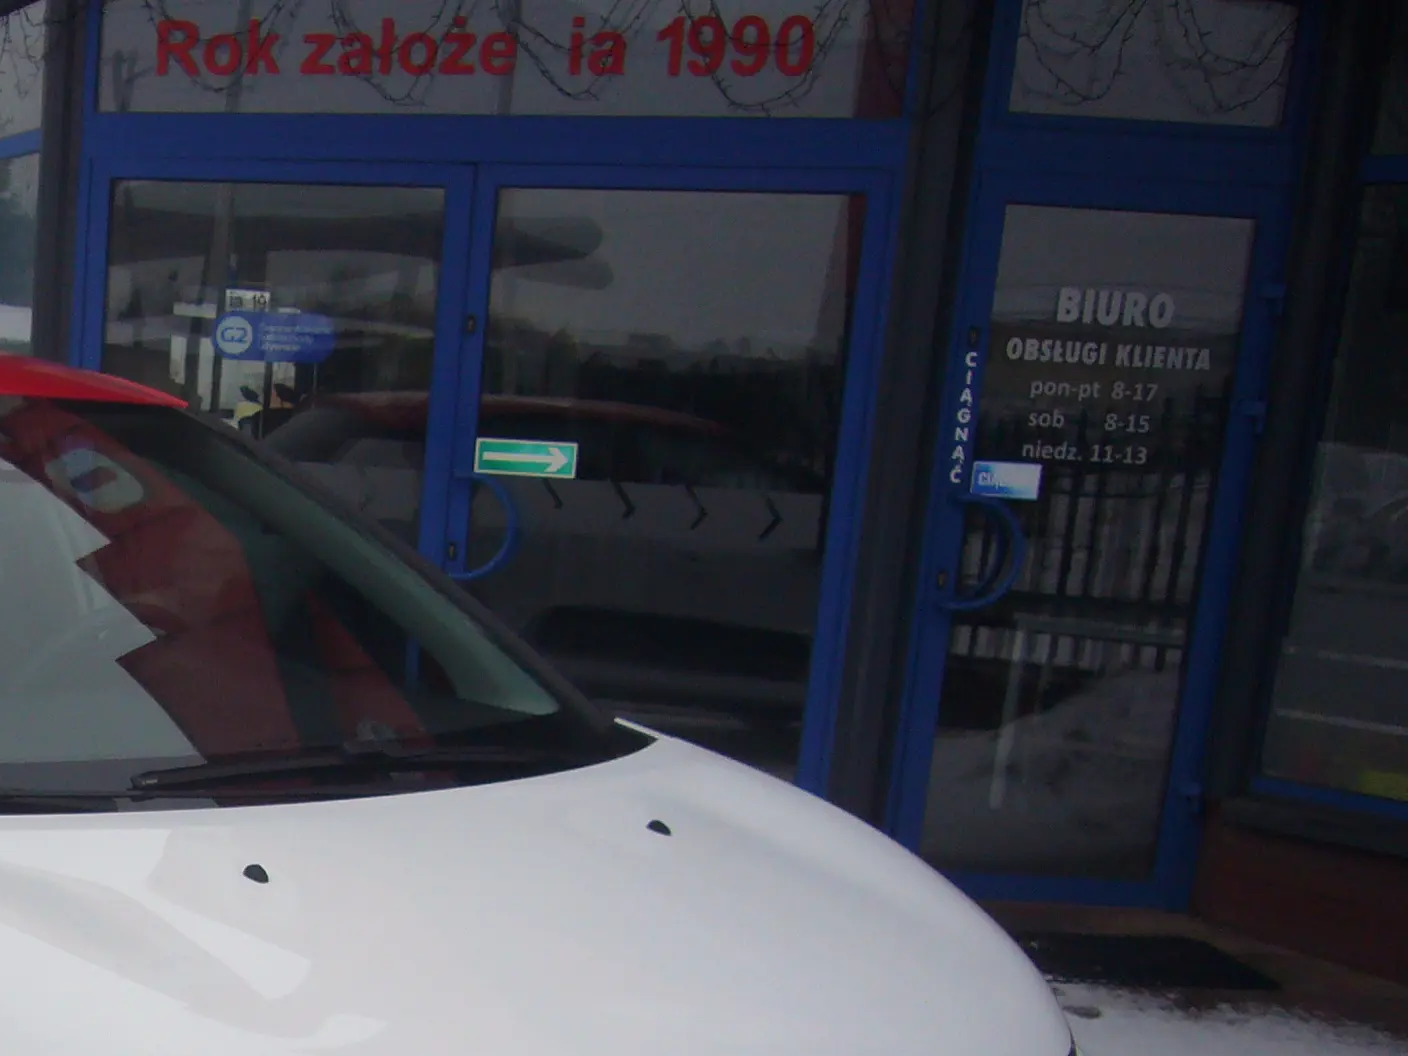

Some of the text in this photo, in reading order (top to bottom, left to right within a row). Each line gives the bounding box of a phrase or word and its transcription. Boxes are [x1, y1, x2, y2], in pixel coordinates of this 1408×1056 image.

[154, 18, 280, 76] Rok
[656, 14, 815, 78] 1990
[1056, 286, 1176, 329] BIURO
[1006, 336, 1211, 371] OBSŁUGI KLIENTA
[1029, 379, 1159, 402] pon-pt 8-17
[1028, 408, 1151, 433] sob 8-15
[1021, 440, 1148, 465] niedz. 11-13
